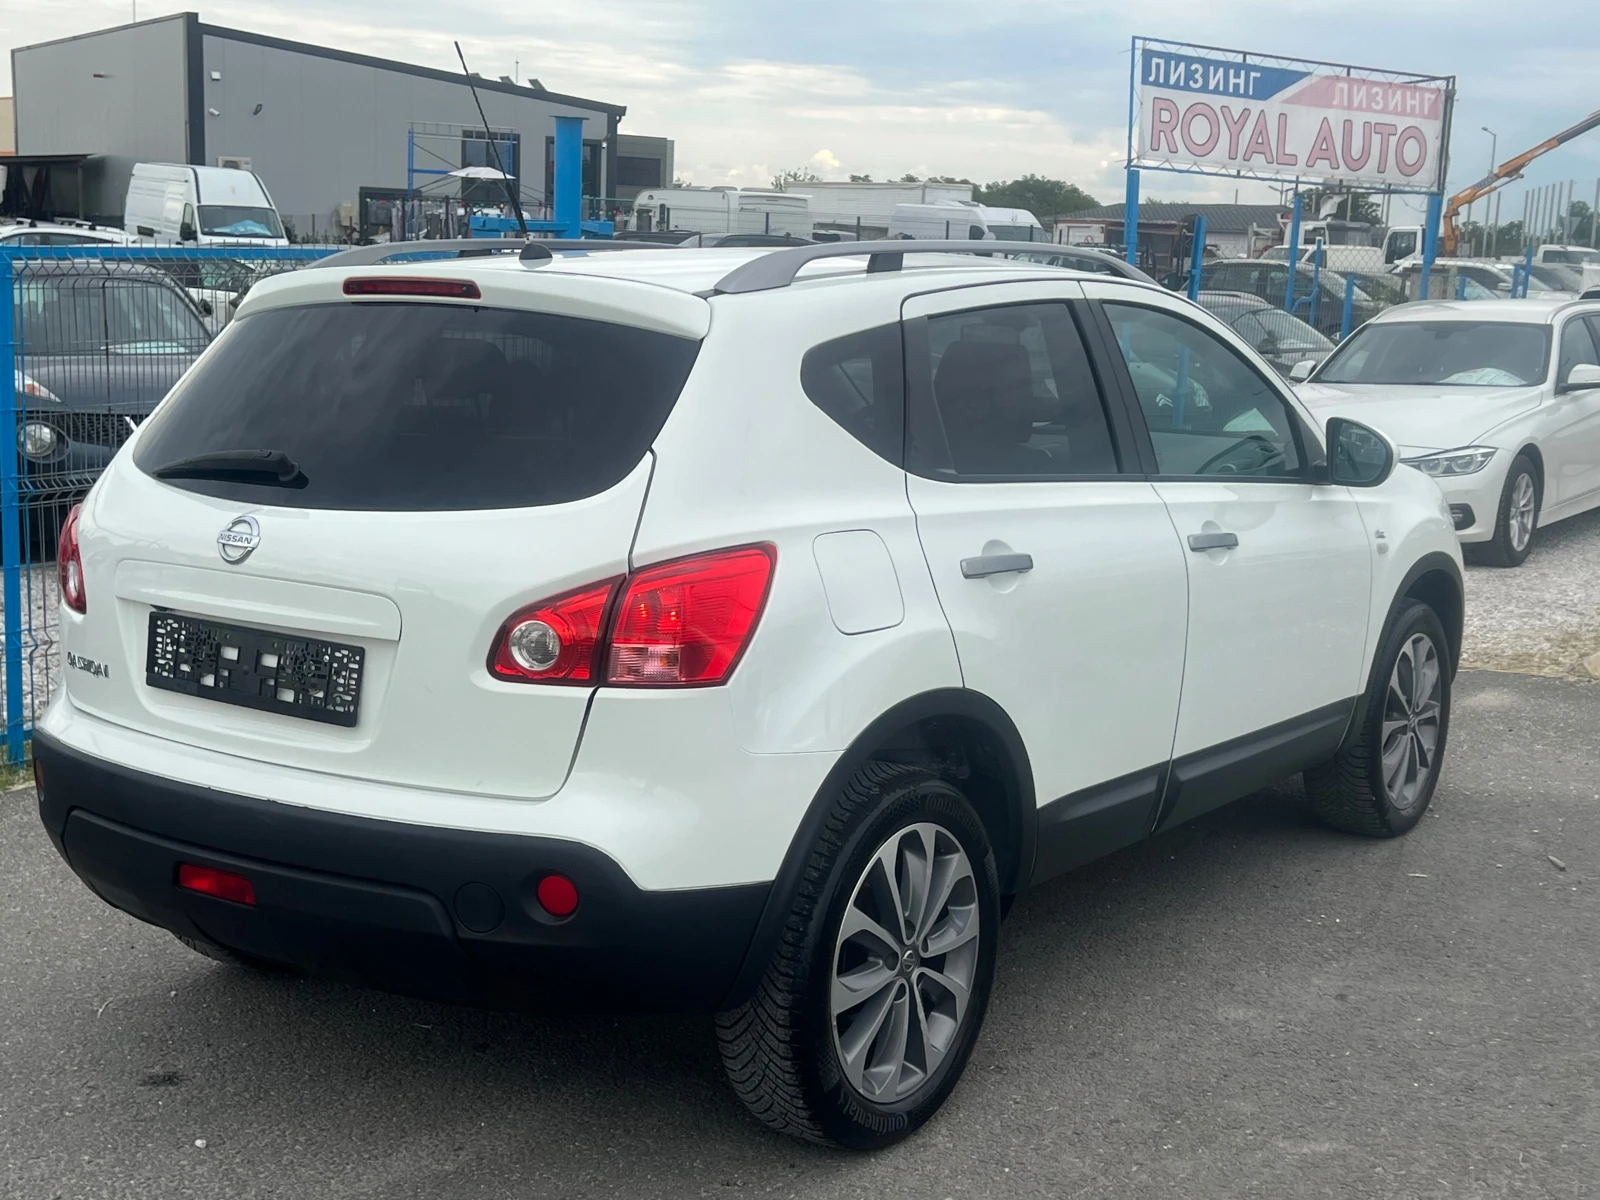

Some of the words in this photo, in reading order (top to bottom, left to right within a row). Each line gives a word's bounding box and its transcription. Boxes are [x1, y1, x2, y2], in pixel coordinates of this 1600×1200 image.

[1148, 57, 1261, 95] ЛИЗИНГ
[1333, 84, 1438, 115] ЛИЗИНГ
[1151, 97, 1298, 166] ROYAL
[1306, 117, 1428, 177] AUTO
[220, 533, 252, 544] NISSAN
